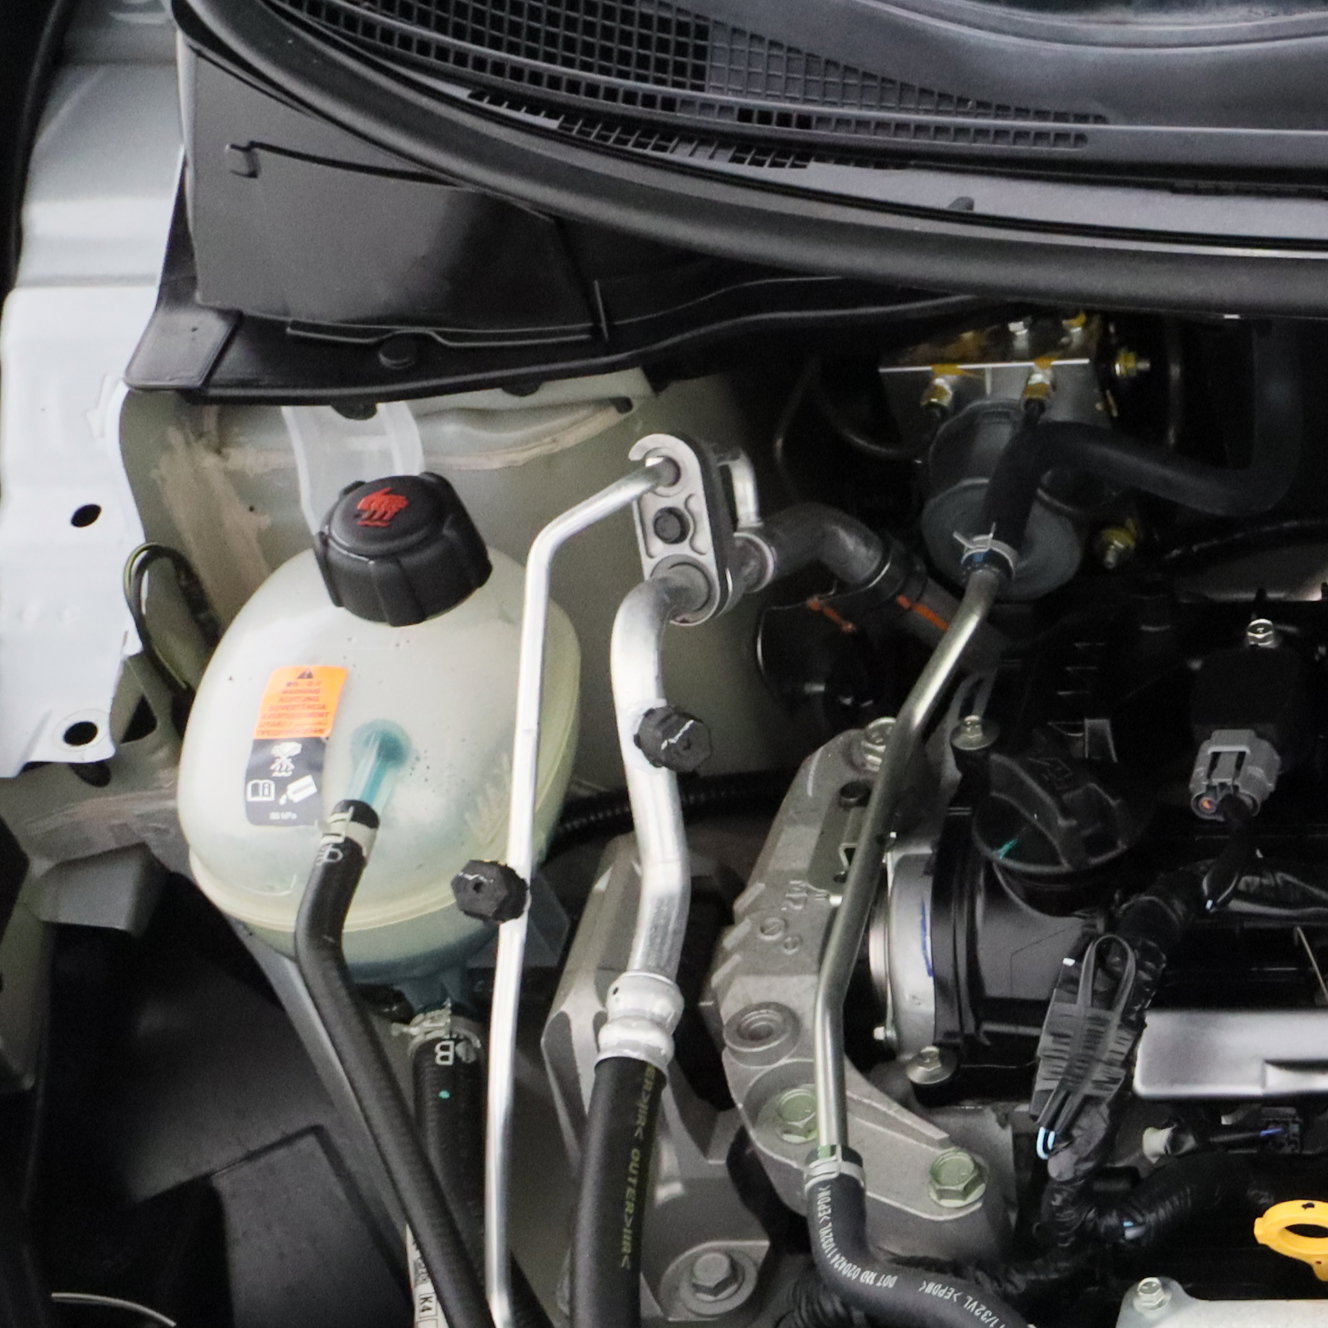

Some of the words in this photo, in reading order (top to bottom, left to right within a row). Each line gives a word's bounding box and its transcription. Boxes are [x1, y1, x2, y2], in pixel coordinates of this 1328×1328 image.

[434, 1040, 455, 1066] B
[875, 1273, 898, 1289] DOT
[917, 1279, 963, 1303] >EPDM<
[420, 1295, 433, 1313] K4
